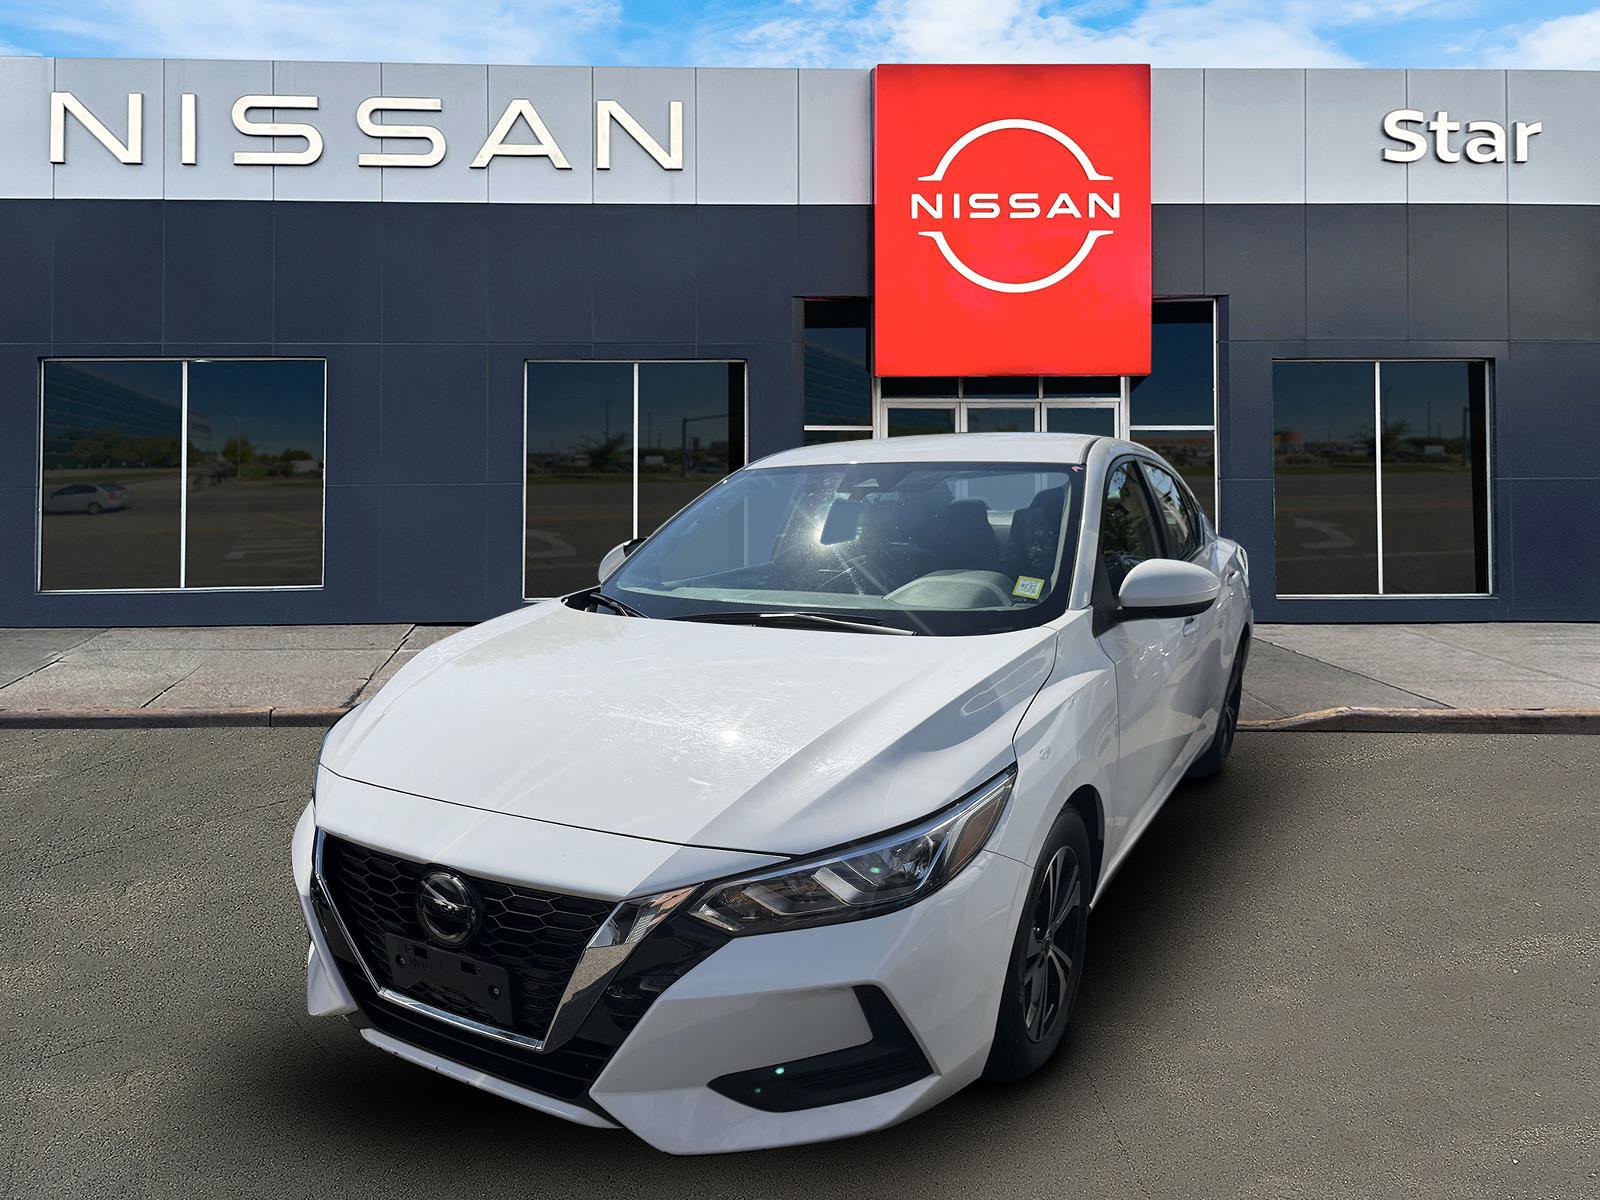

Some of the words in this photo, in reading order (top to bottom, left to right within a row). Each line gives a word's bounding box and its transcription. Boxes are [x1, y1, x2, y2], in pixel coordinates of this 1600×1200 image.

[50, 91, 684, 170] NISSAN
[1382, 109, 1543, 164] Star
[911, 192, 1121, 219] NISSAN
